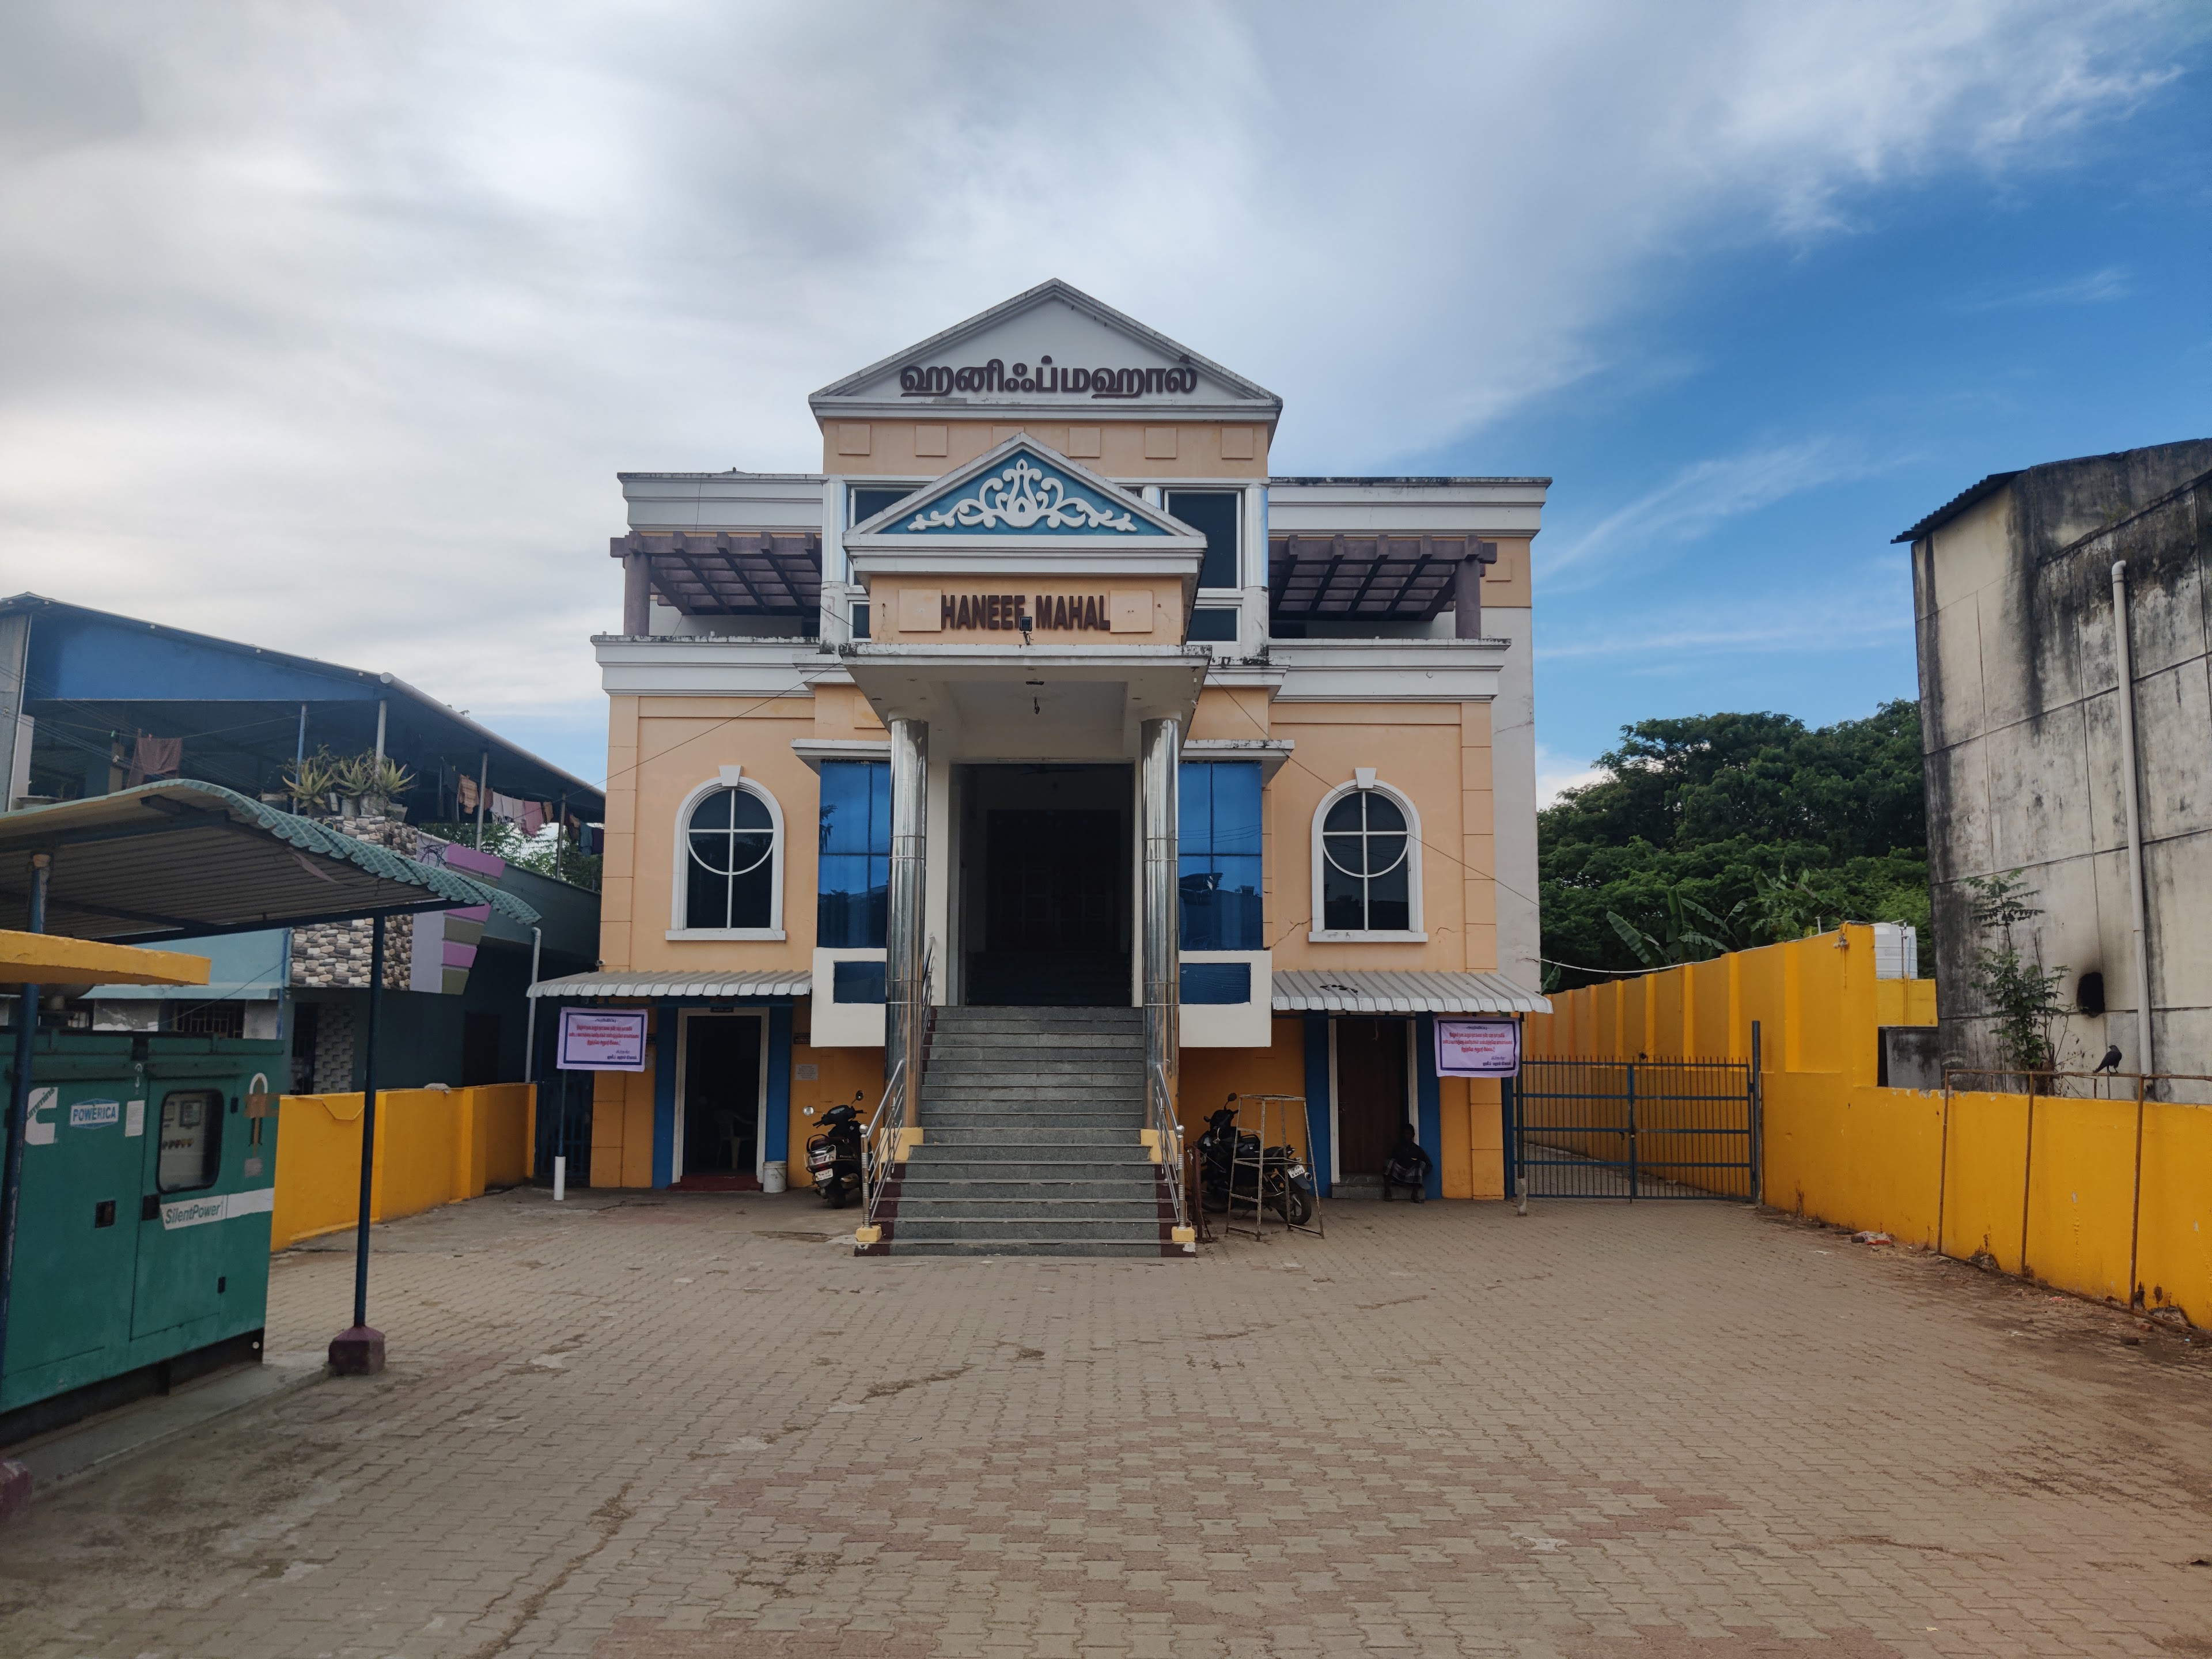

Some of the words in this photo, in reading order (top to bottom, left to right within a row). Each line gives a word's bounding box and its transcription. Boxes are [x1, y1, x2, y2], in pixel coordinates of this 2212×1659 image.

[941, 595, 1025, 630] HANEEF
[1036, 596, 1110, 630] MAHAL
[73, 1106, 116, 1122] POWERICA
[165, 1204, 221, 1224] SilentPower
